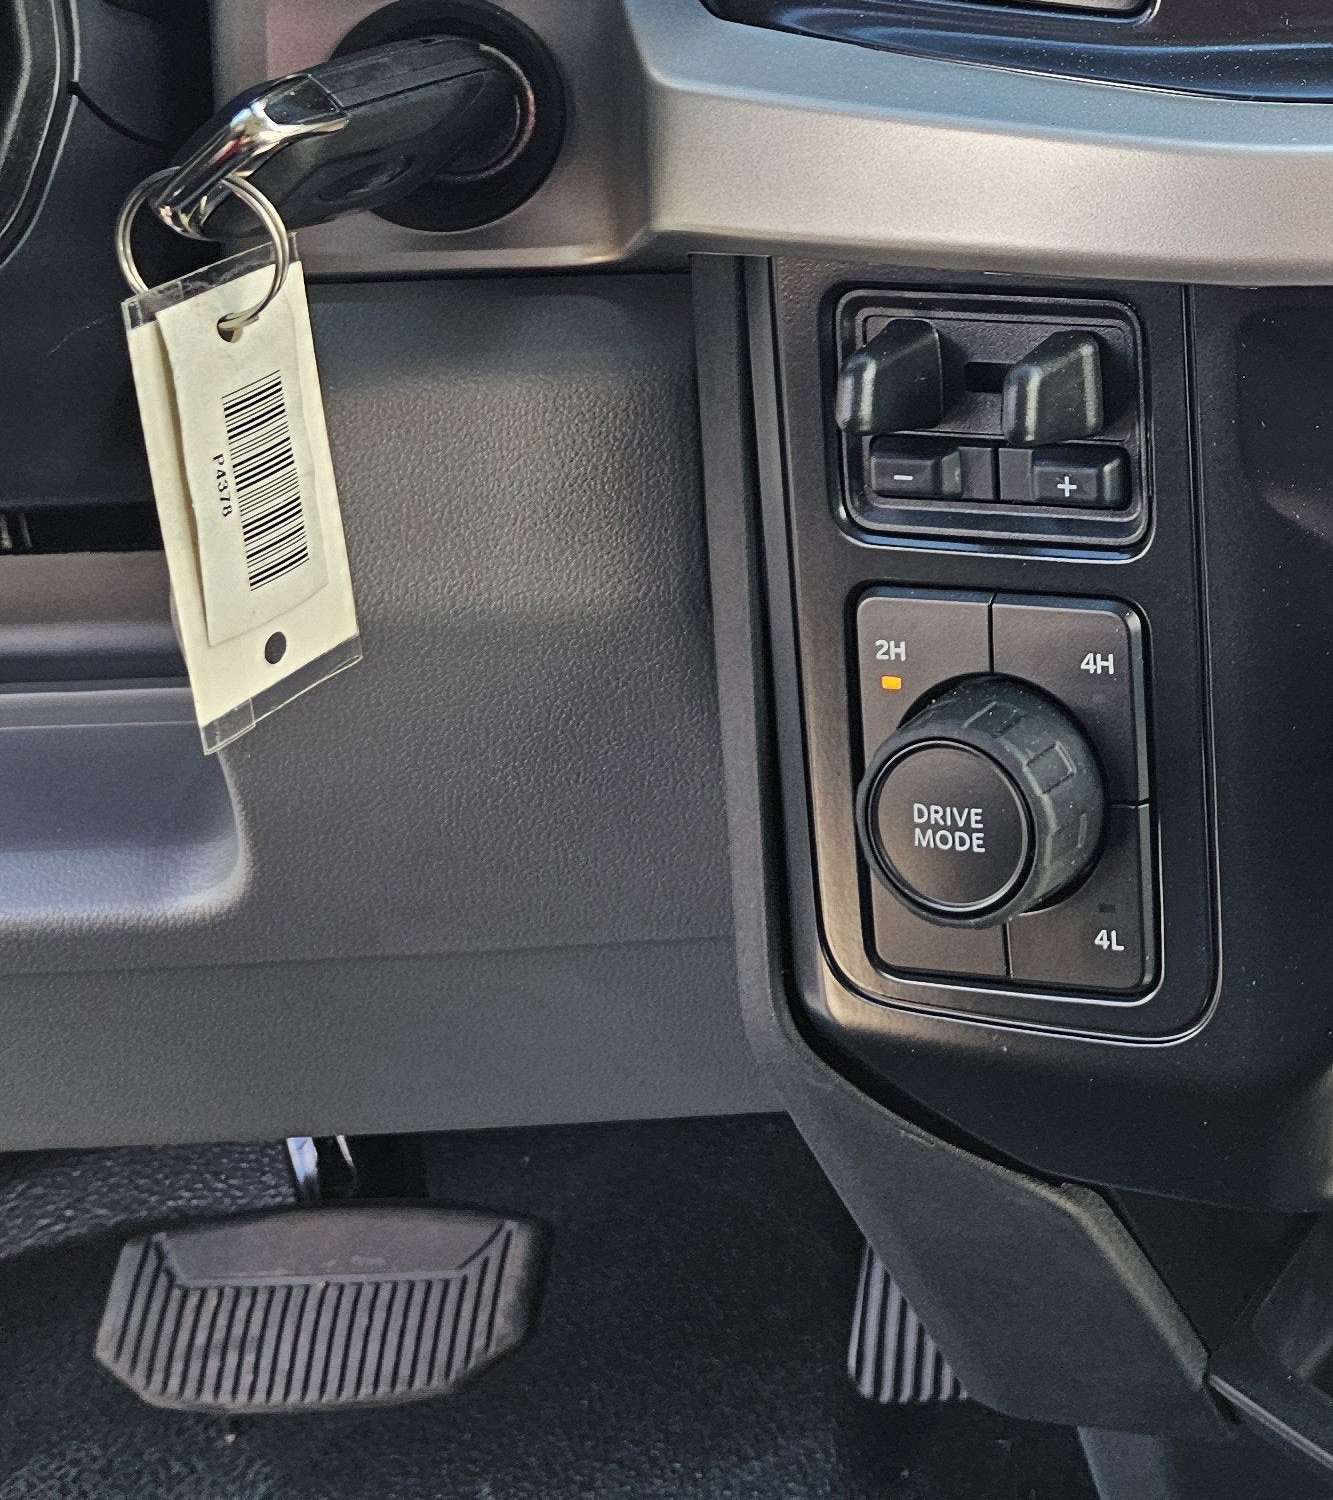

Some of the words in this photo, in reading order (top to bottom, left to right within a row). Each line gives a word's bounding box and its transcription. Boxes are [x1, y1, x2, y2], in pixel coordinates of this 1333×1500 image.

[875, 639, 907, 662] 2H
[1080, 652, 1115, 676] 4H
[912, 802, 984, 830] DRIVE
[913, 827, 987, 854] MODE
[1094, 929, 1126, 953] 4L
